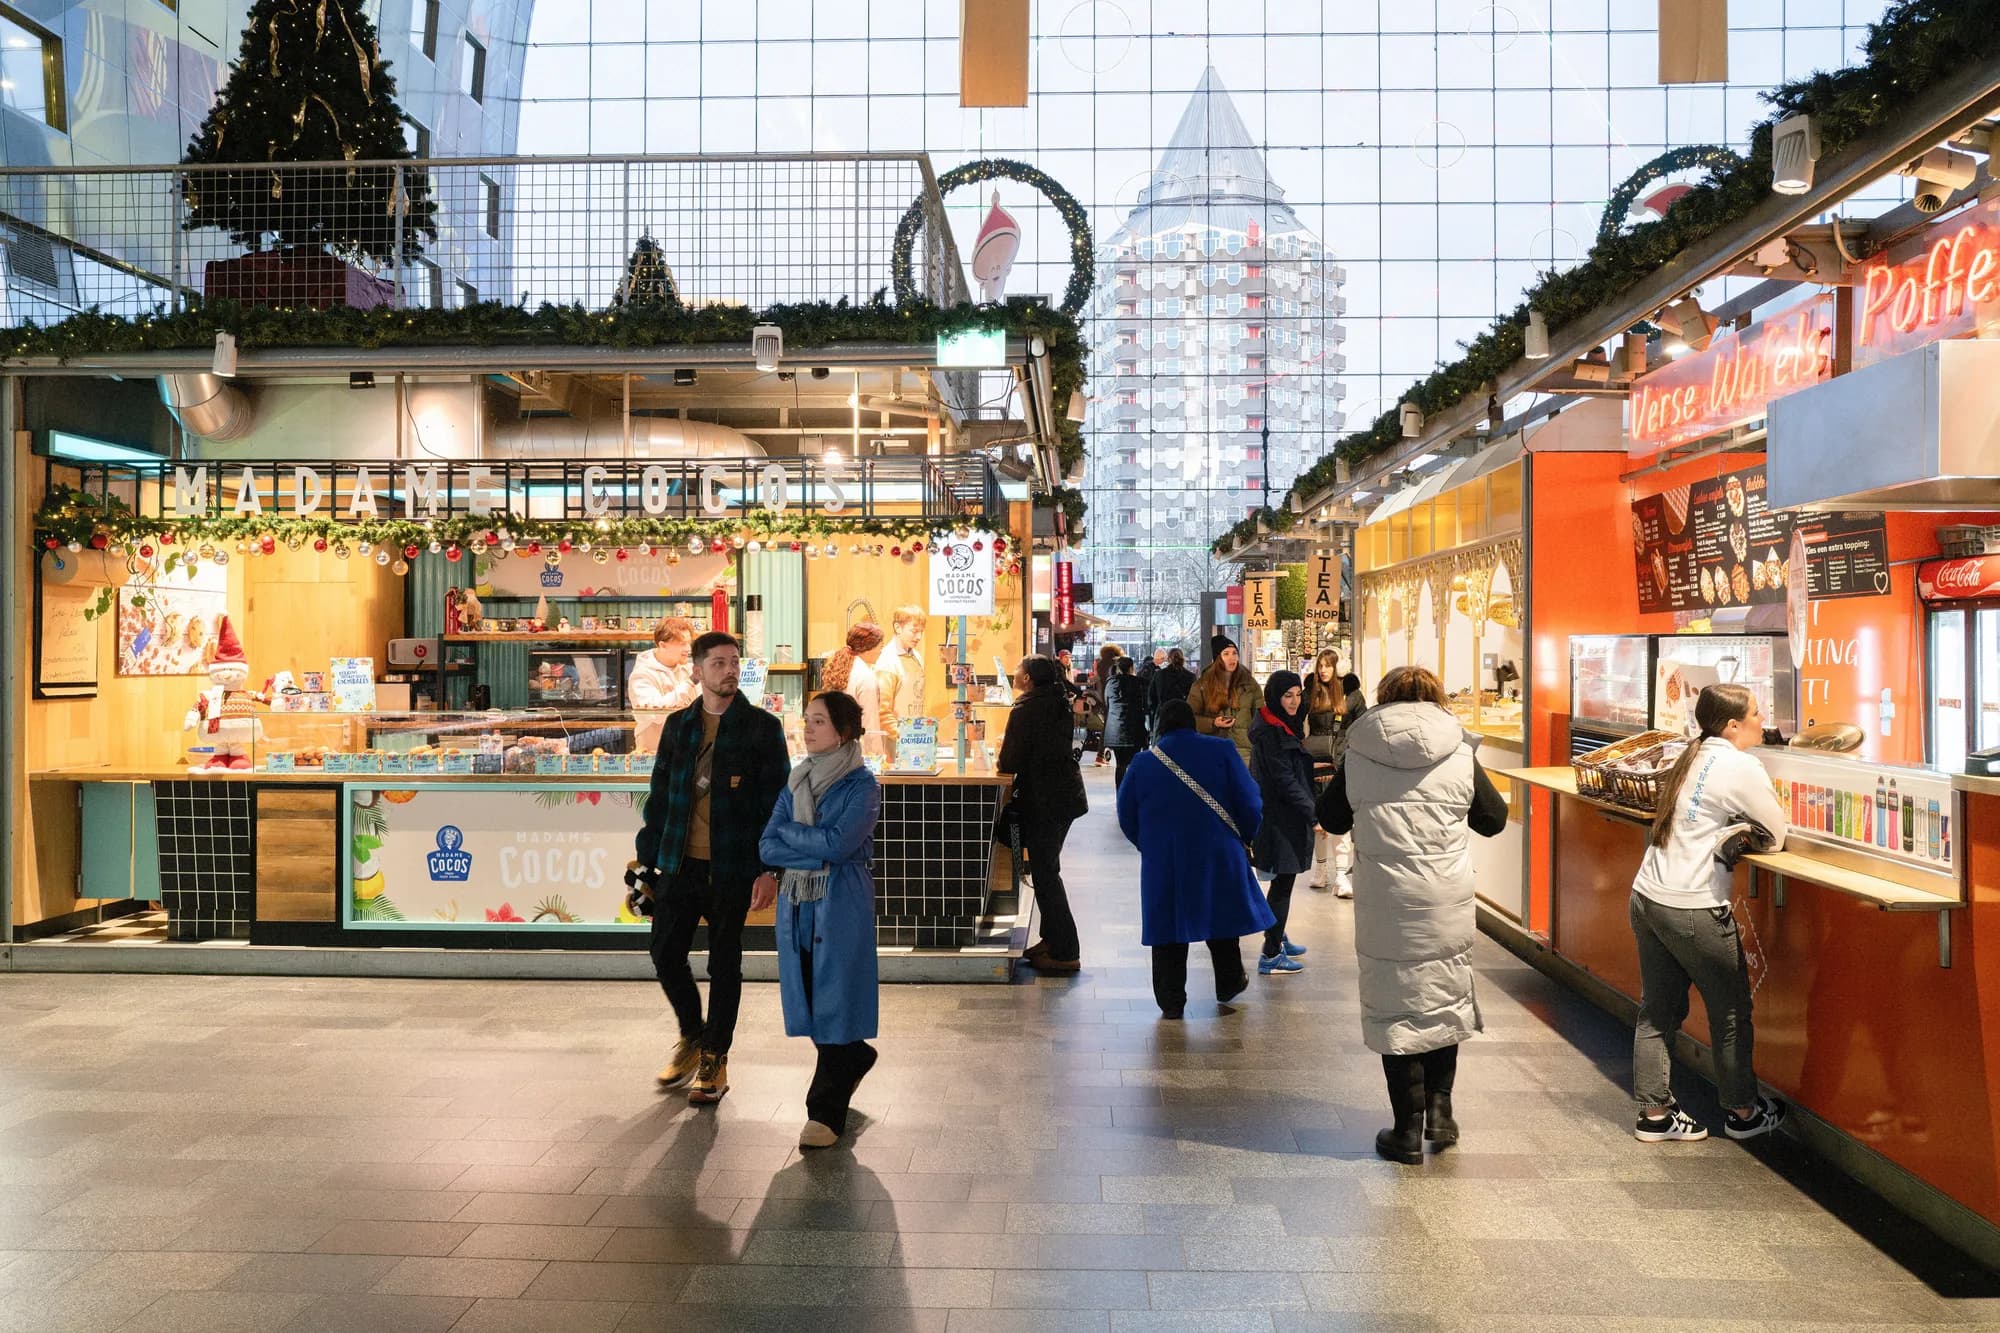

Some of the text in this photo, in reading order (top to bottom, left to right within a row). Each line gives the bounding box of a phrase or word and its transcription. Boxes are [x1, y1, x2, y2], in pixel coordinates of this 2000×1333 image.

[1632, 312, 1823, 439] Verse Wafels
[175, 464, 845, 516] MADAME COCOS
[1829, 543, 1843, 551] extra
[1844, 539, 1870, 550] topping:
[937, 578, 984, 596] COCOS
[1315, 556, 1331, 605] TEA
[1253, 581, 1264, 617] TEA
[1306, 608, 1338, 620] SHOP
[1247, 619, 1269, 628] BAR
[516, 832, 592, 843] MADAME
[430, 858, 469, 873] COCOS
[500, 847, 608, 888] COCOS
